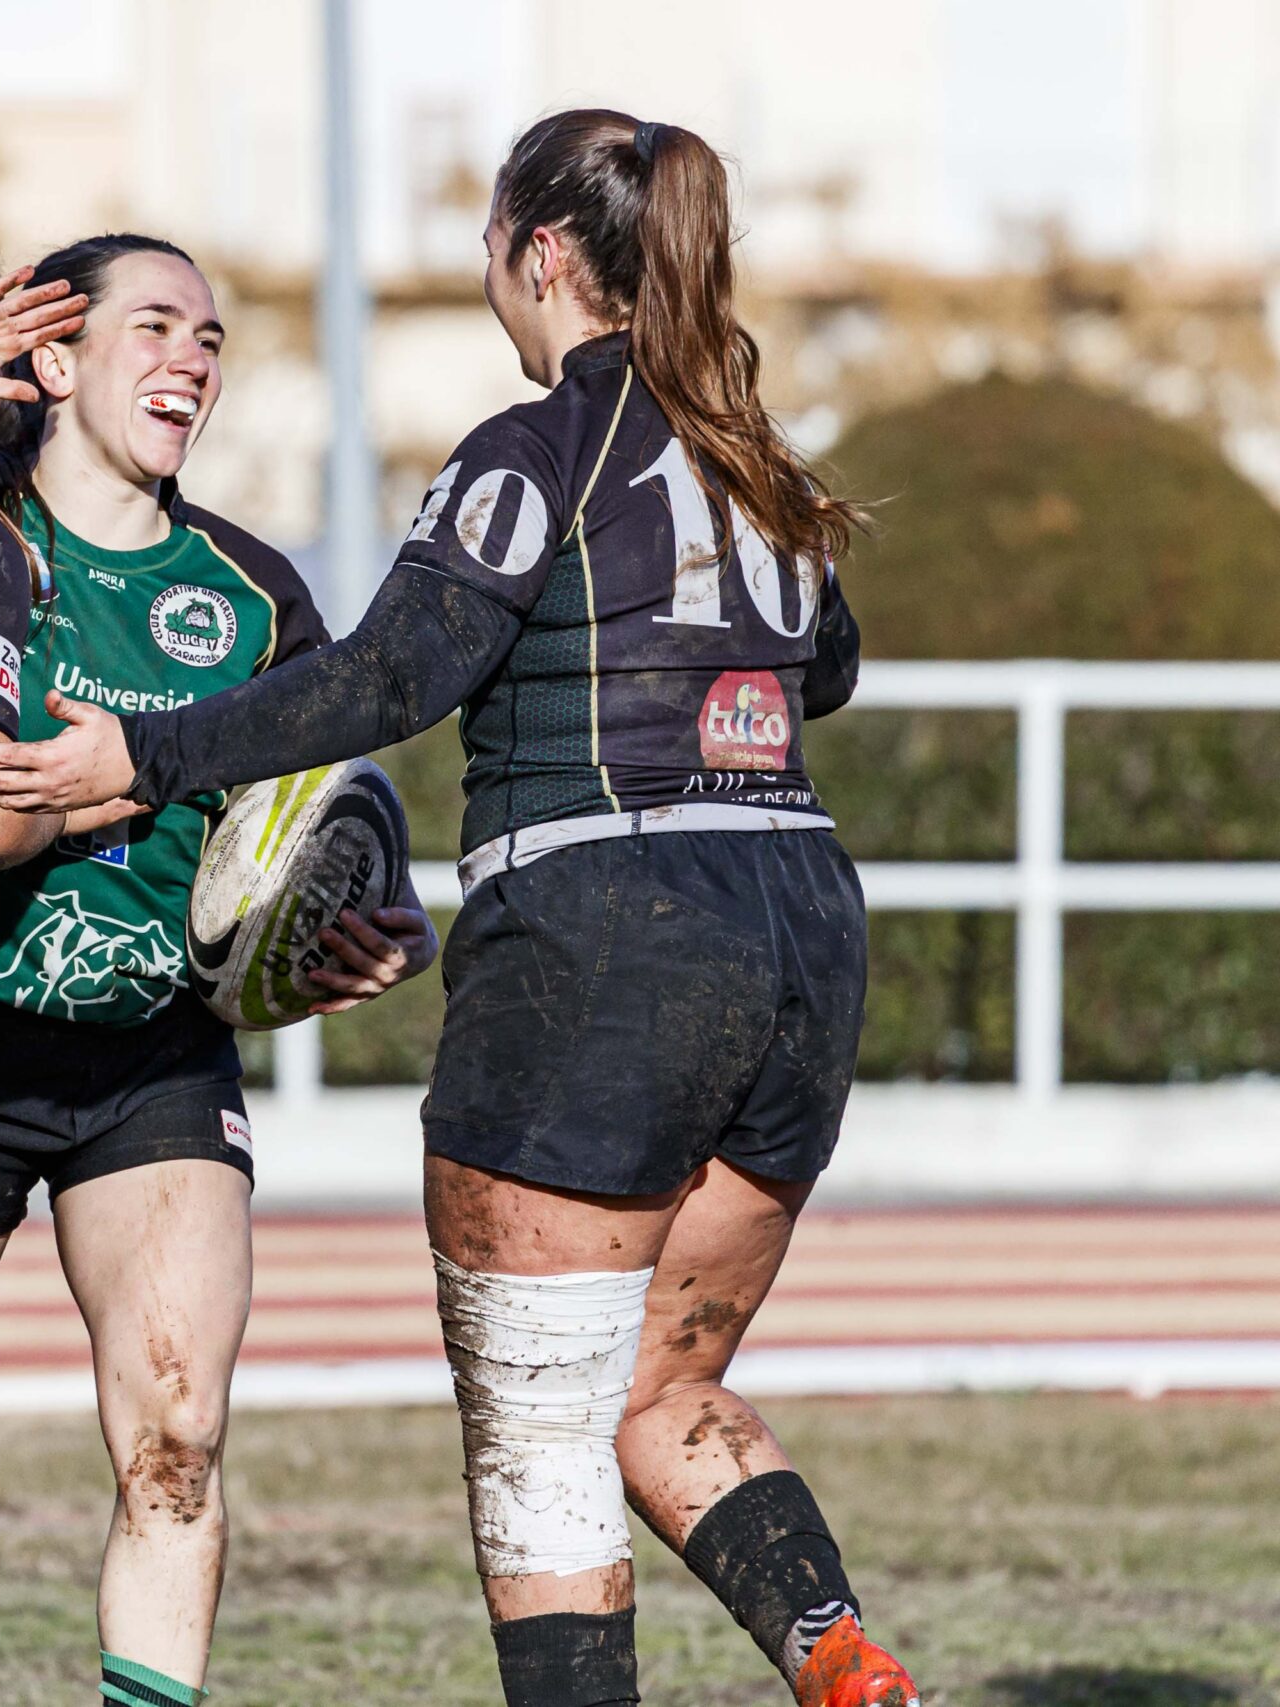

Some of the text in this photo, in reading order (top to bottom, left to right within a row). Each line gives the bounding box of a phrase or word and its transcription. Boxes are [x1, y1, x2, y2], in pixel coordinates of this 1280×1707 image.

[402, 460, 548, 576] 10
[629, 437, 819, 638] 10
[88, 568, 126, 590] AMURA
[151, 585, 235, 651] CLUB DEPORTIVO UNIVERSITARIO
[168, 630, 218, 652] RUGBY
[706, 700, 787, 747] tuco
